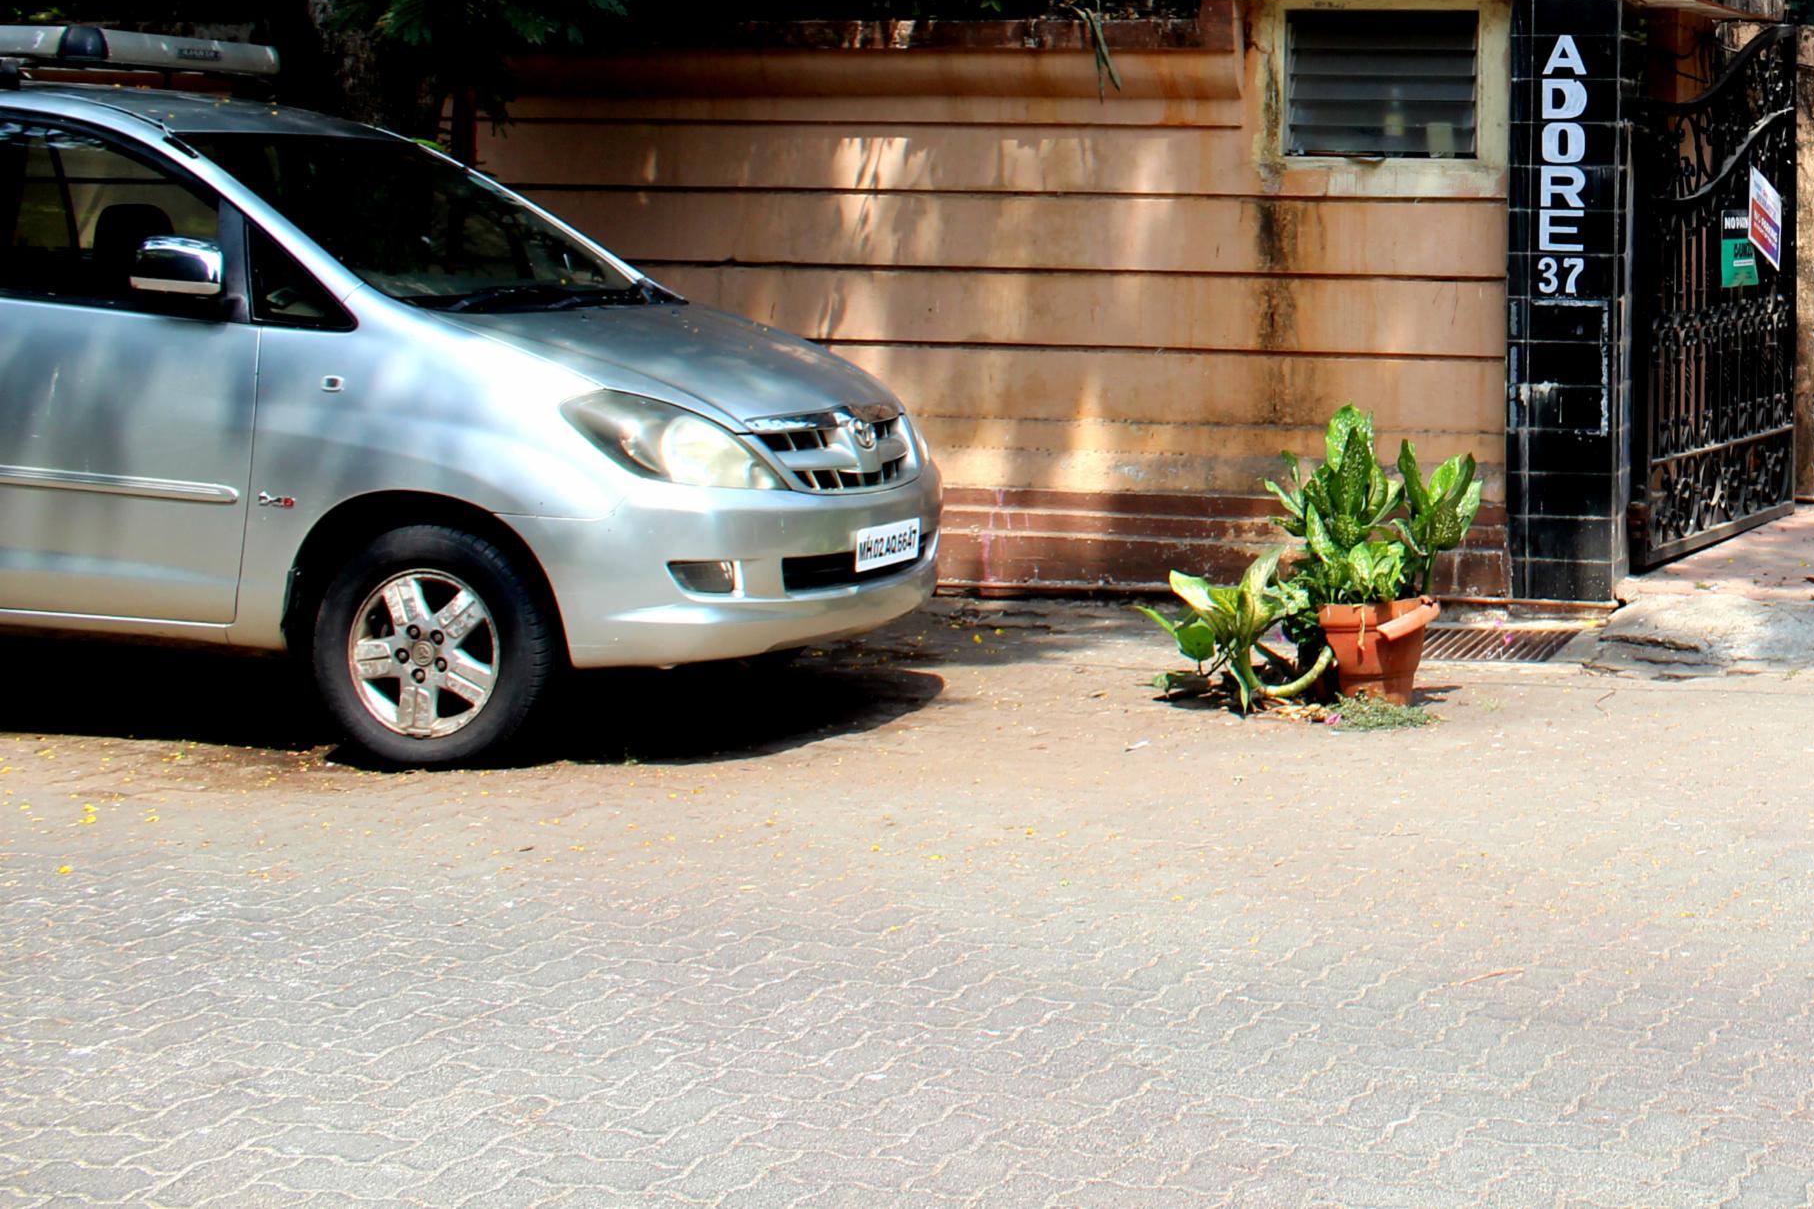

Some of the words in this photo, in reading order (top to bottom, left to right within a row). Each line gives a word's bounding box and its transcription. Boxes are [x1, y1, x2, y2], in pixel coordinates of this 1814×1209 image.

[1539, 34, 1587, 251] ADORE
[1724, 216, 1735, 229] NO
[1537, 256, 1585, 294] 37
